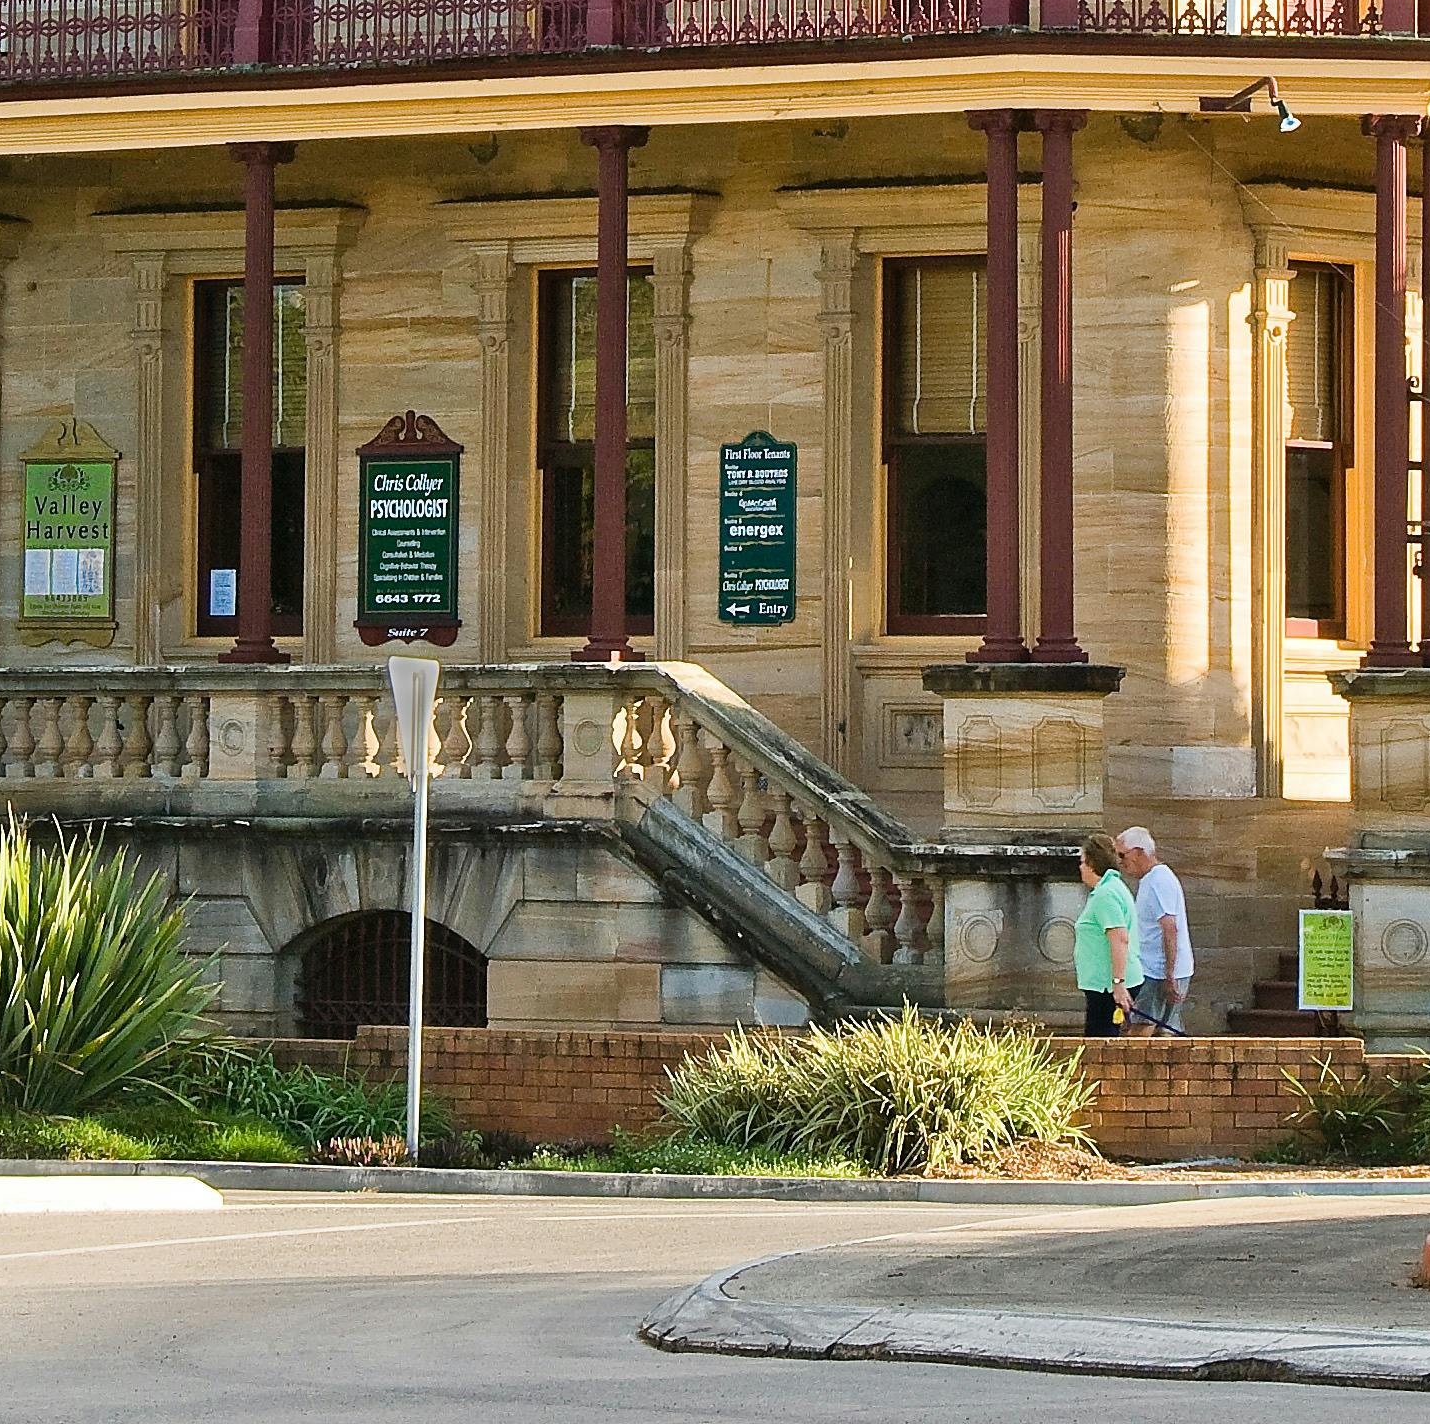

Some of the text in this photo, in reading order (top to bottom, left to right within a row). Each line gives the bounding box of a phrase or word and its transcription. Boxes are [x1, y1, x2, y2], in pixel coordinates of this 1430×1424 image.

[725, 448, 790, 459] First Floor Tenants
[374, 473, 443, 496] Chris Collyer
[34, 495, 102, 520] Valley
[371, 499, 448, 518] PSYCHOLOGIST
[26, 521, 108, 539] Harvest
[729, 525, 783, 538] energex
[375, 594, 441, 603] 6643 1772
[759, 602, 788, 616] Entry
[387, 628, 429, 637] Suite 7
